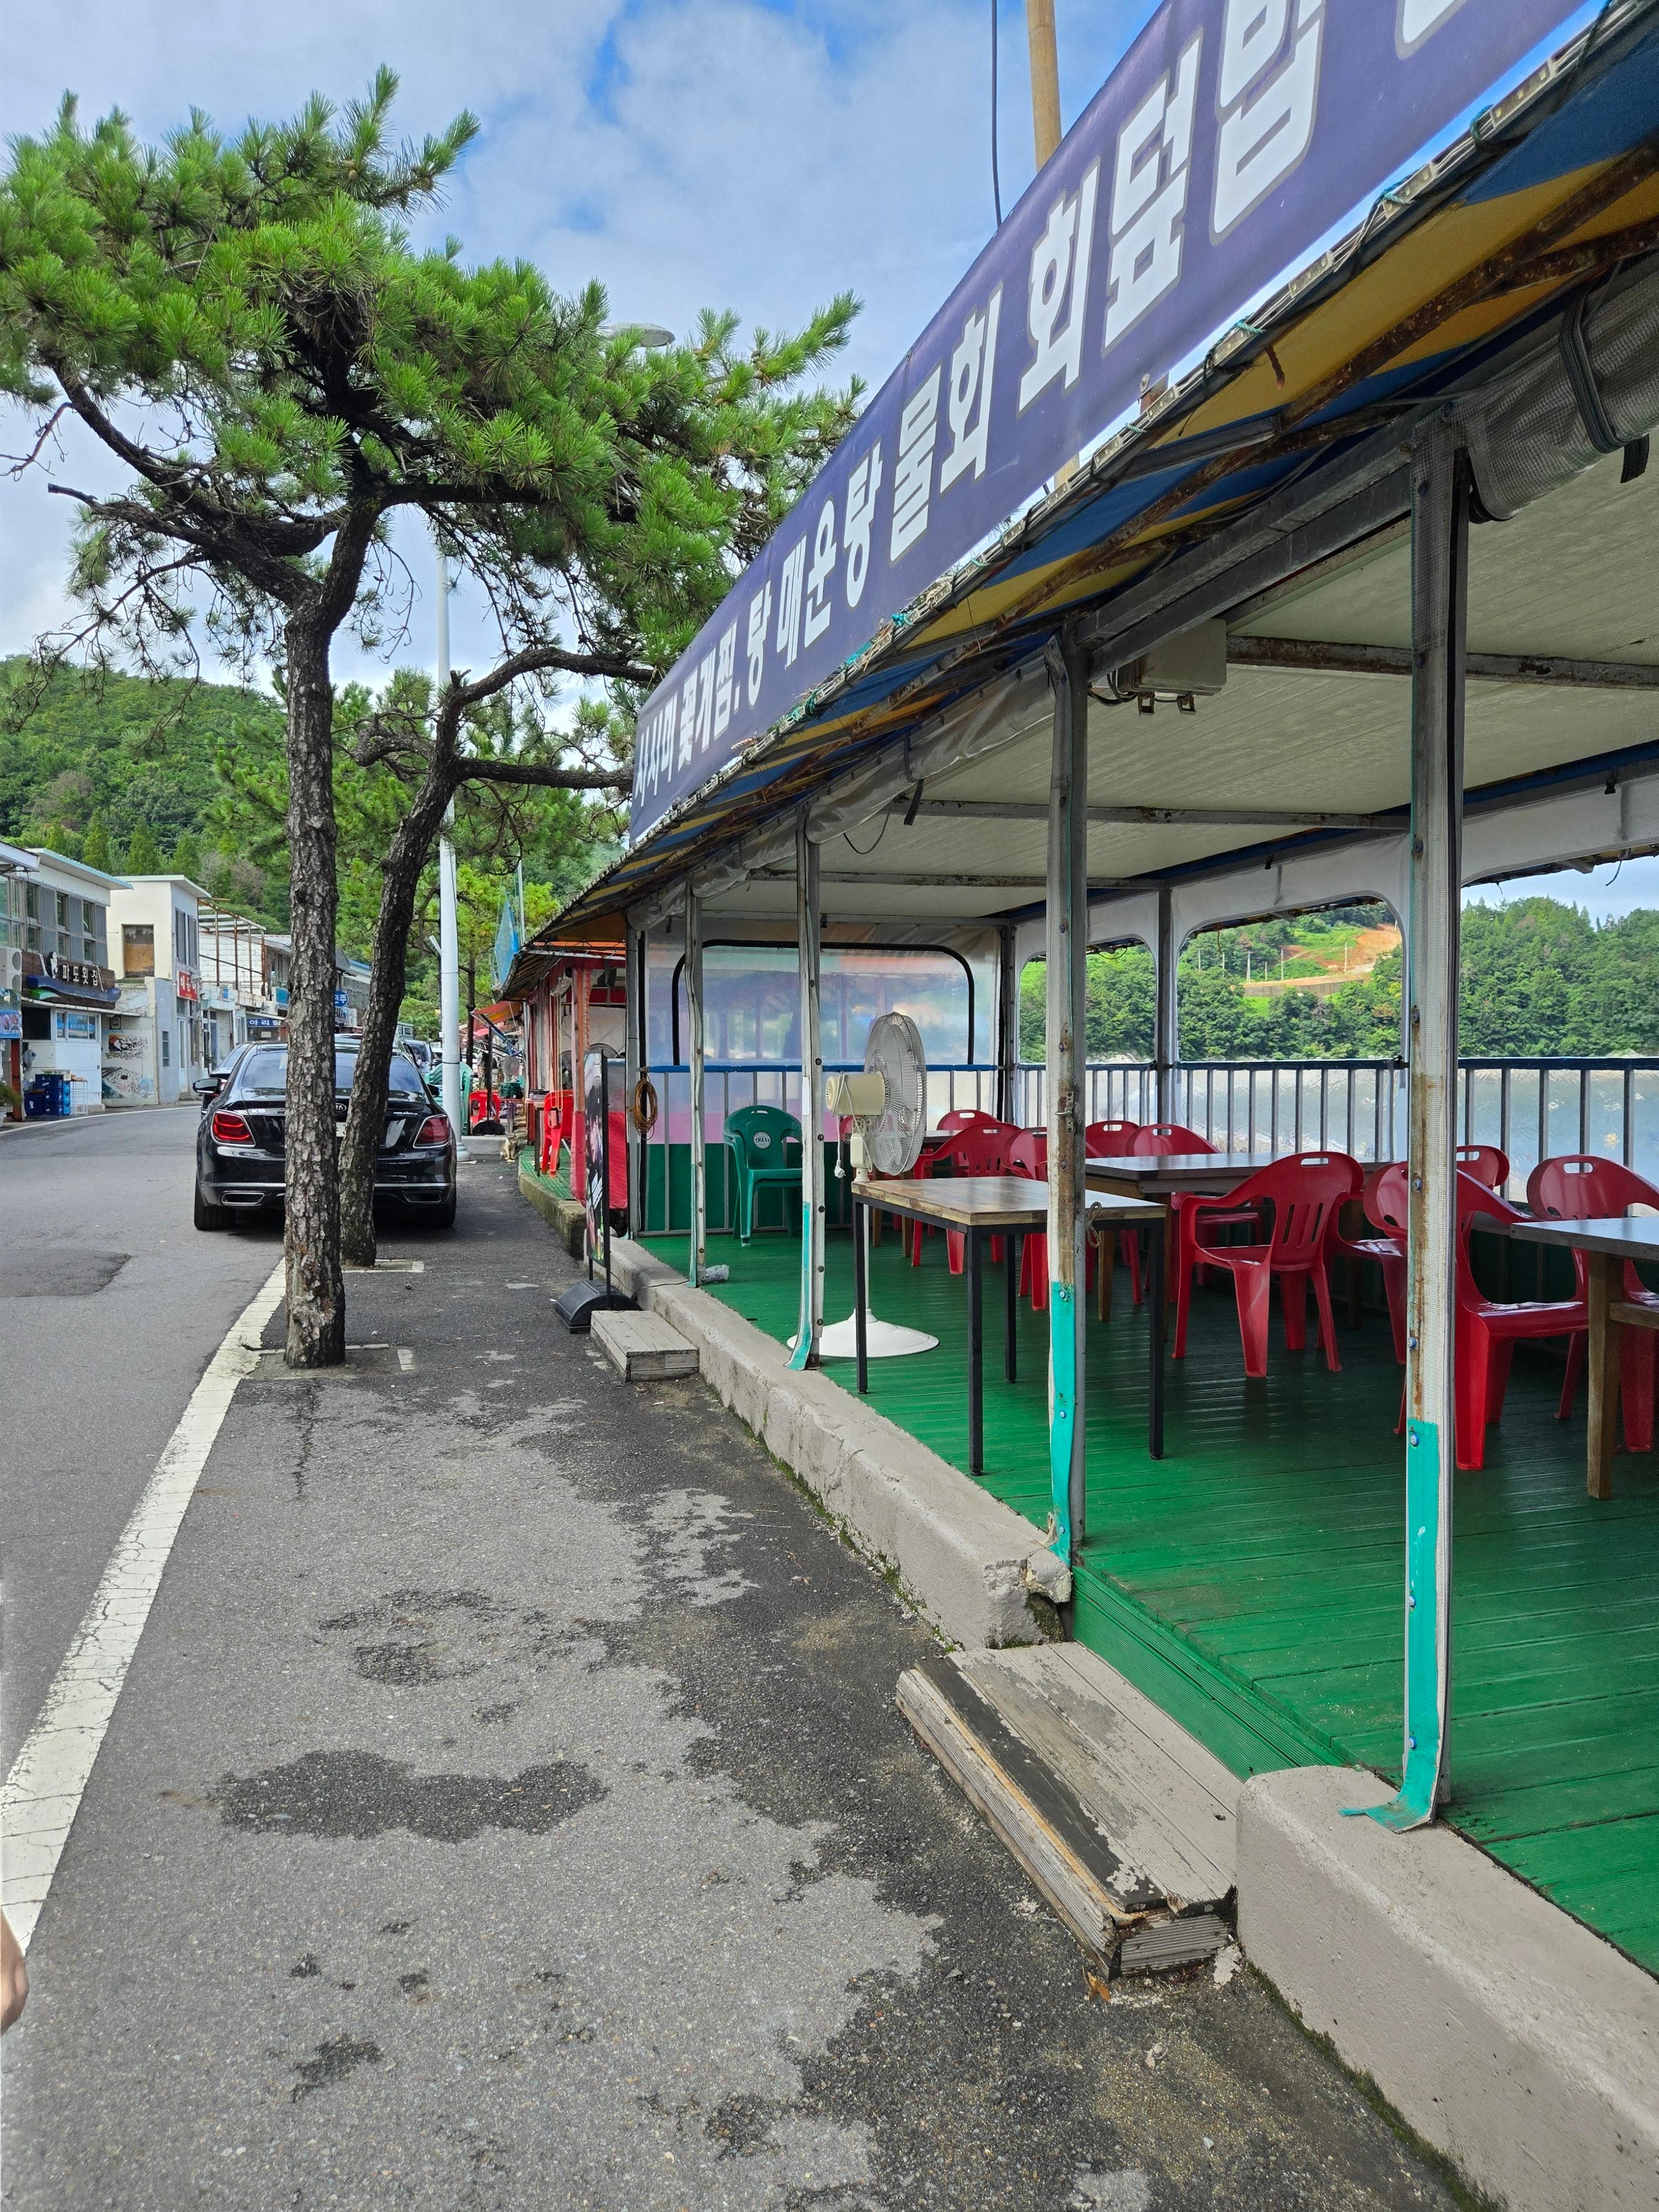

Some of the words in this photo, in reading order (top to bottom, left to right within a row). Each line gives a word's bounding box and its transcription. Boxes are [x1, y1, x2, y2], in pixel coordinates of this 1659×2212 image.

[635, 693, 678, 807] 사시미
[776, 441, 884, 669] 매운탕
[889, 285, 1003, 563] 물회
[62, 963, 98, 986] 파도횟집
